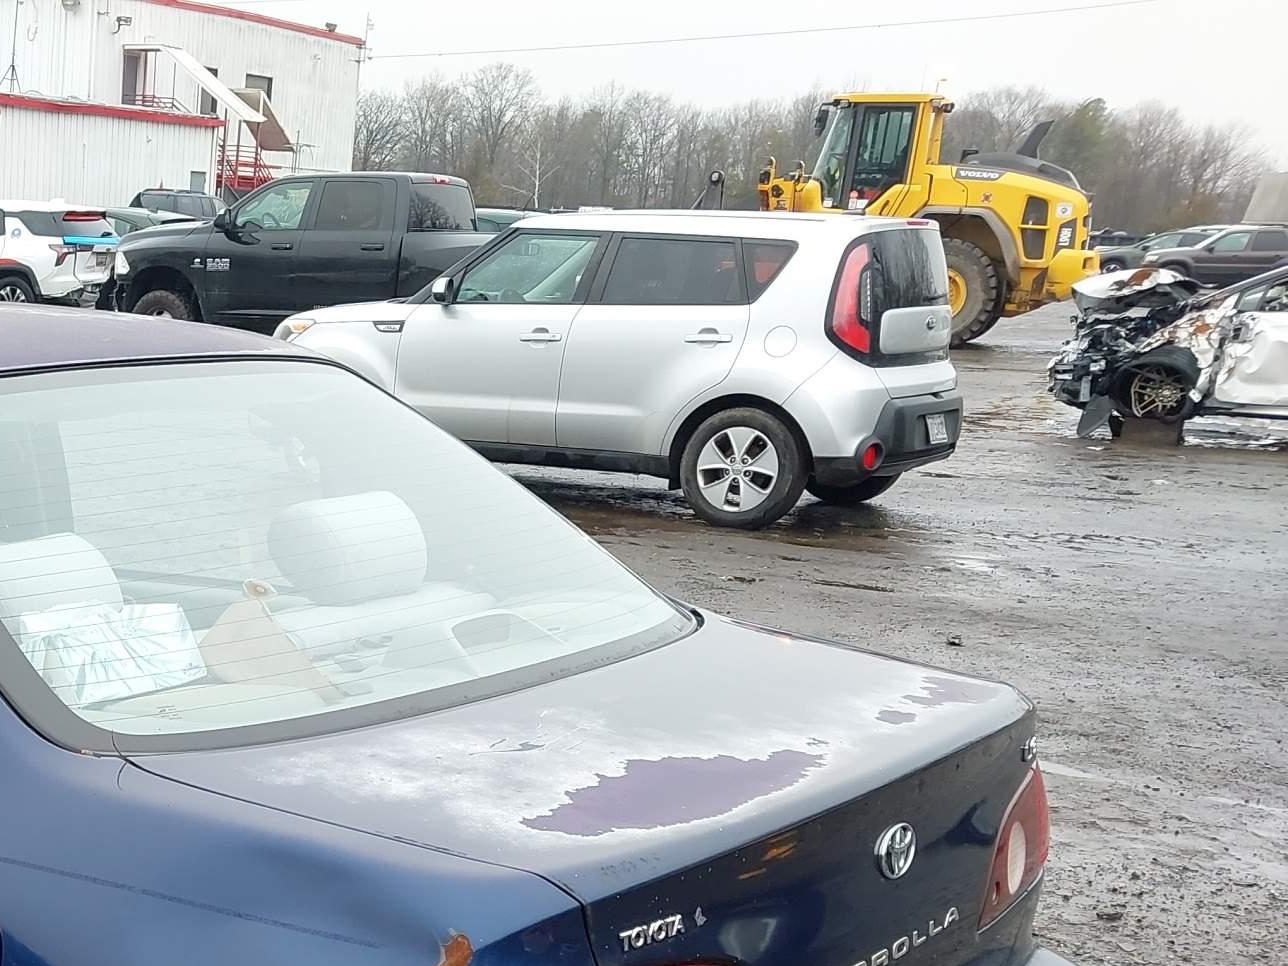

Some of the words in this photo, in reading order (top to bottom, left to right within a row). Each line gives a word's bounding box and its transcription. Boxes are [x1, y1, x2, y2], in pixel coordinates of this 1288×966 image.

[959, 170, 999, 179] VOLVO
[1057, 227, 1073, 246] L90H
[619, 914, 685, 951] TOYOTA
